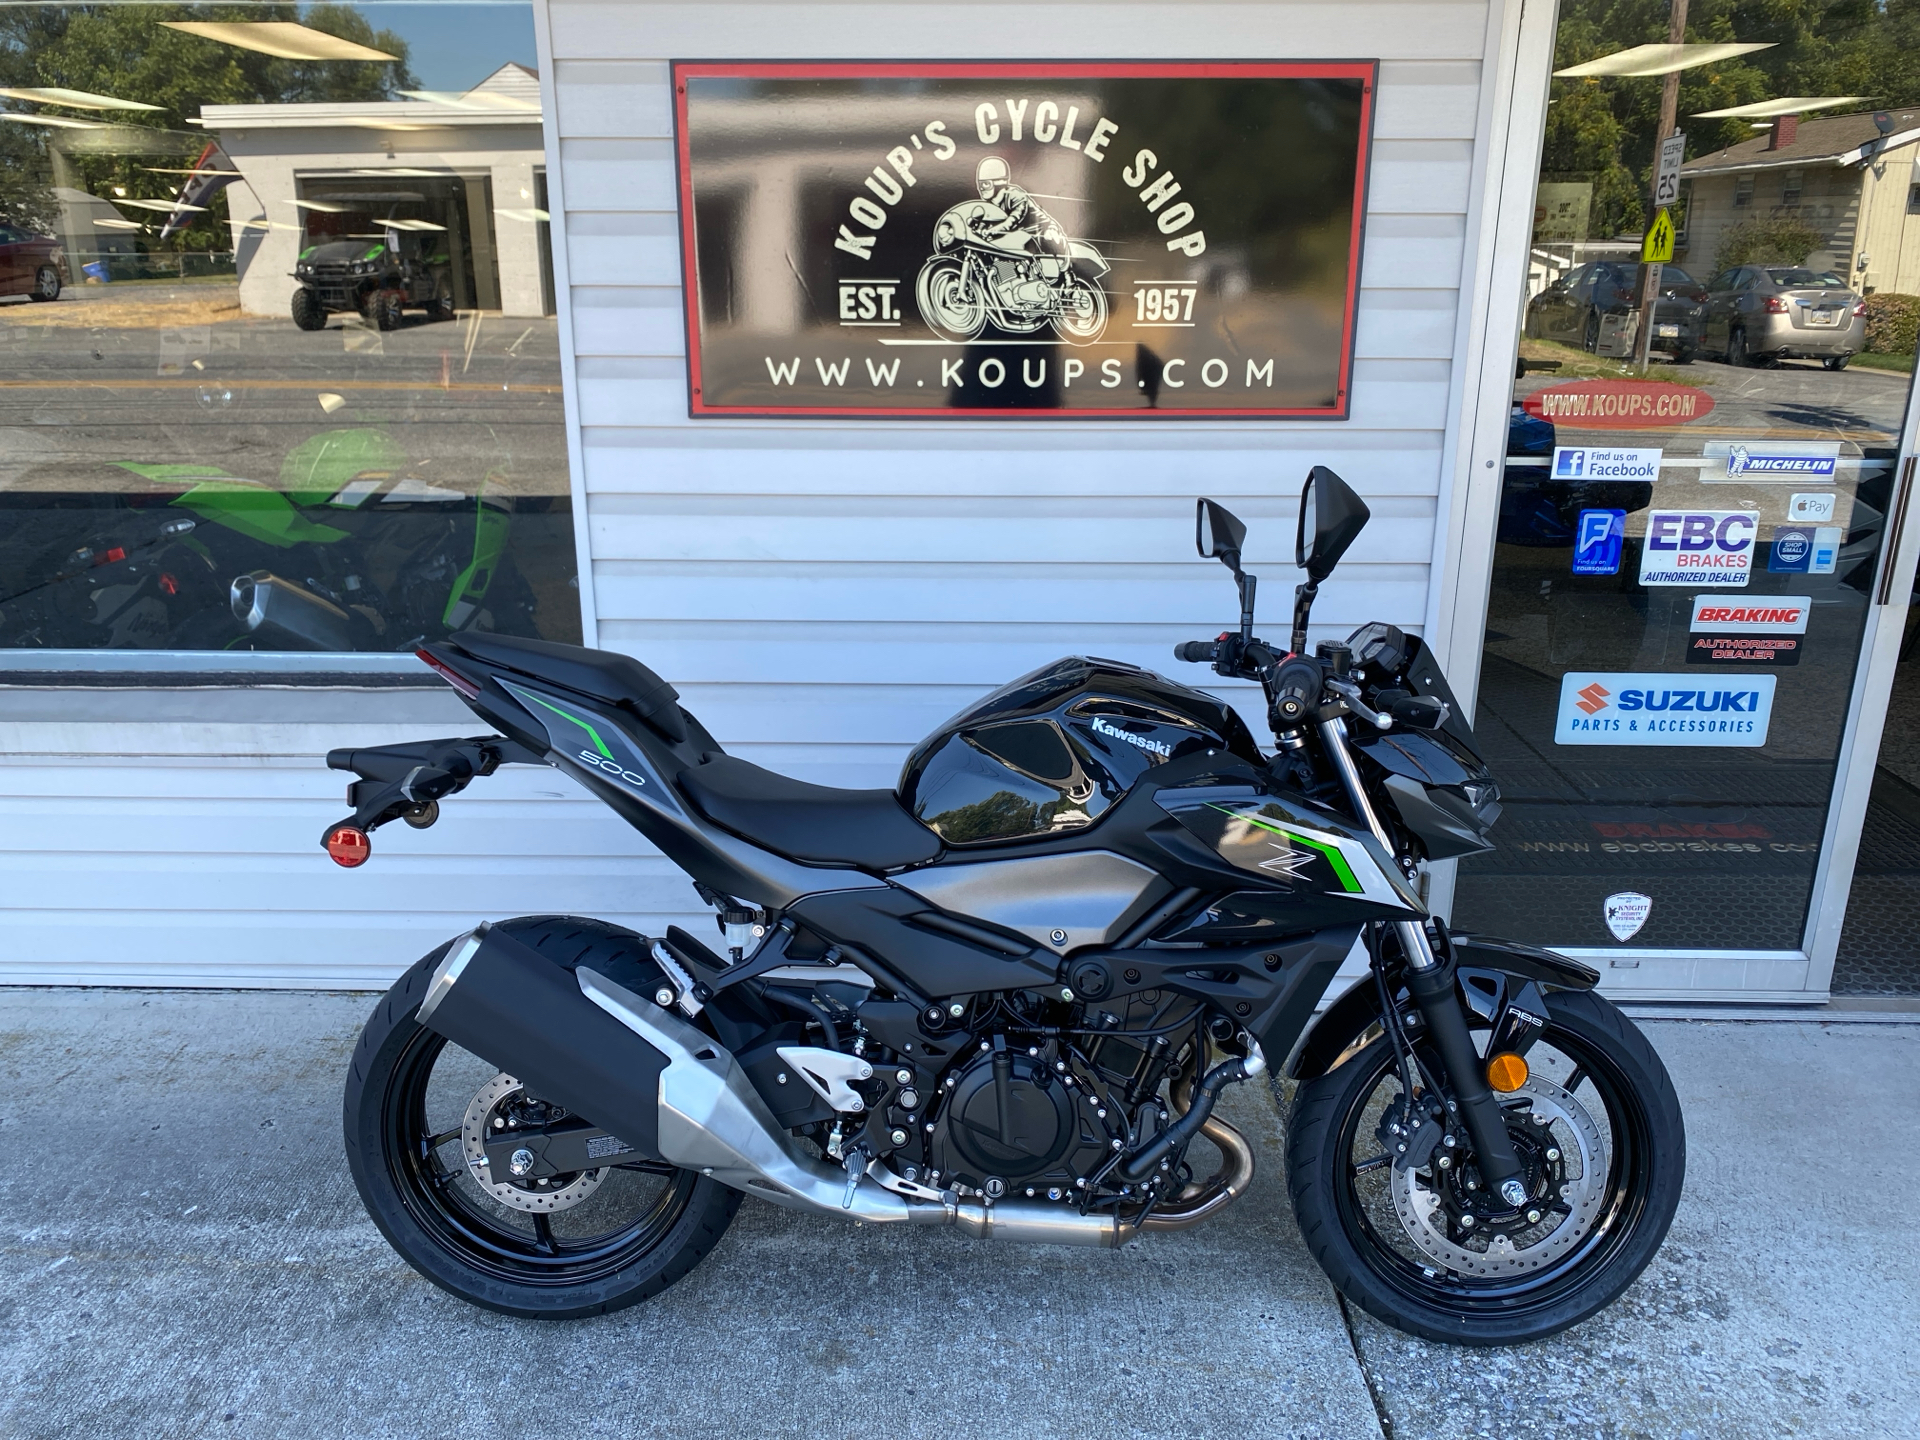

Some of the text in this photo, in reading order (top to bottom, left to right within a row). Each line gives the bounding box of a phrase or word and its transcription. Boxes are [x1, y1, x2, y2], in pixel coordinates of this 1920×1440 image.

[833, 98, 1207, 262] KOUP'S CYCLE SHOP
[839, 287, 901, 321] EST.
[1134, 288, 1196, 322] 1957
[764, 356, 1275, 389] WWW.KOUPS.COM
[1542, 394, 1696, 417] WWW.KOUPS.COM
[1590, 451, 1638, 462] Find us on
[1749, 458, 1833, 472] MICHELIN
[1589, 463, 1655, 477] Facebook
[1809, 500, 1830, 514] Pay
[1649, 515, 1754, 552] EBC
[1677, 553, 1748, 568] BRAKES
[1644, 571, 1747, 583] AUTHORIZED DEALER
[1696, 607, 1803, 624] BRAKING
[1694, 638, 1797, 650] AUTHORIZED
[1712, 650, 1775, 660] DEALER
[1617, 689, 1760, 712] SUZUKI
[1572, 718, 1754, 733] PARTS & ACCESSORIES
[1091, 717, 1171, 757] Kawasaki
[578, 750, 646, 786] 500
[1508, 1008, 1544, 1028] ABS
